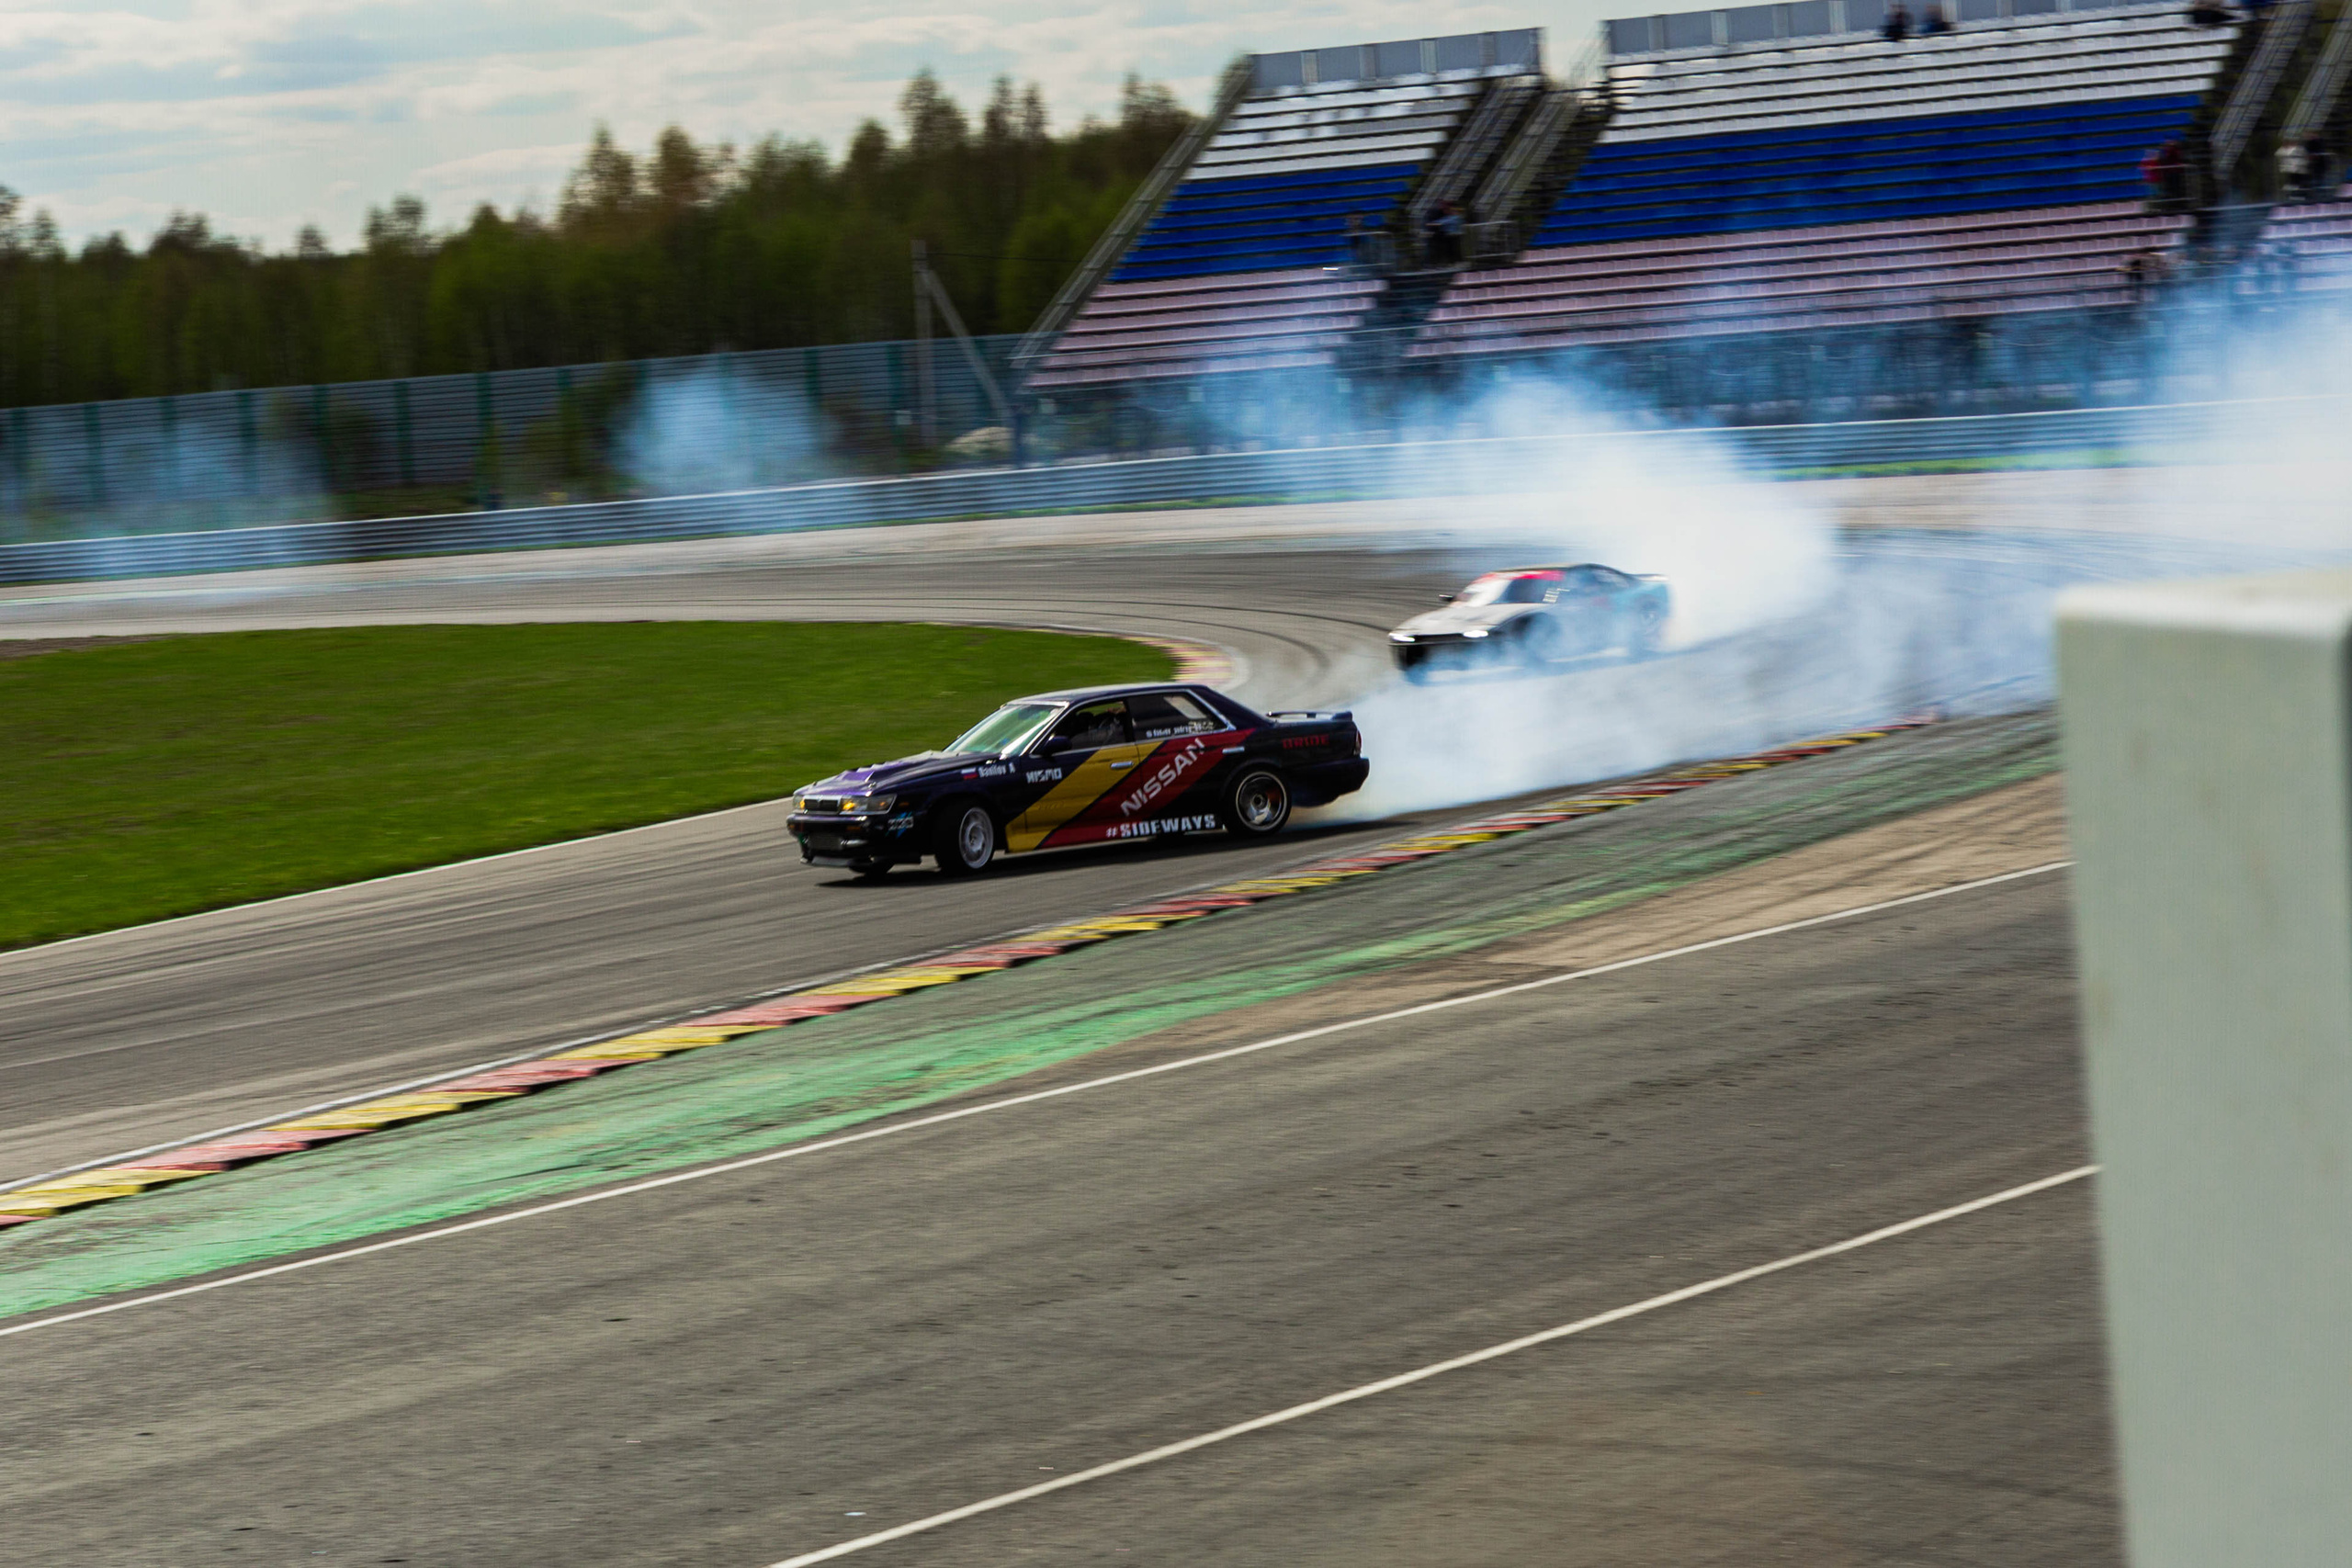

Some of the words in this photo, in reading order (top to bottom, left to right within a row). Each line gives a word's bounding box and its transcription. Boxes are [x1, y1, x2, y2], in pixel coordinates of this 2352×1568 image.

[1025, 767, 1063, 784] NISMO
[1120, 738, 1205, 817] NISSAN
[1105, 813, 1216, 838] #SIDEWAYS
